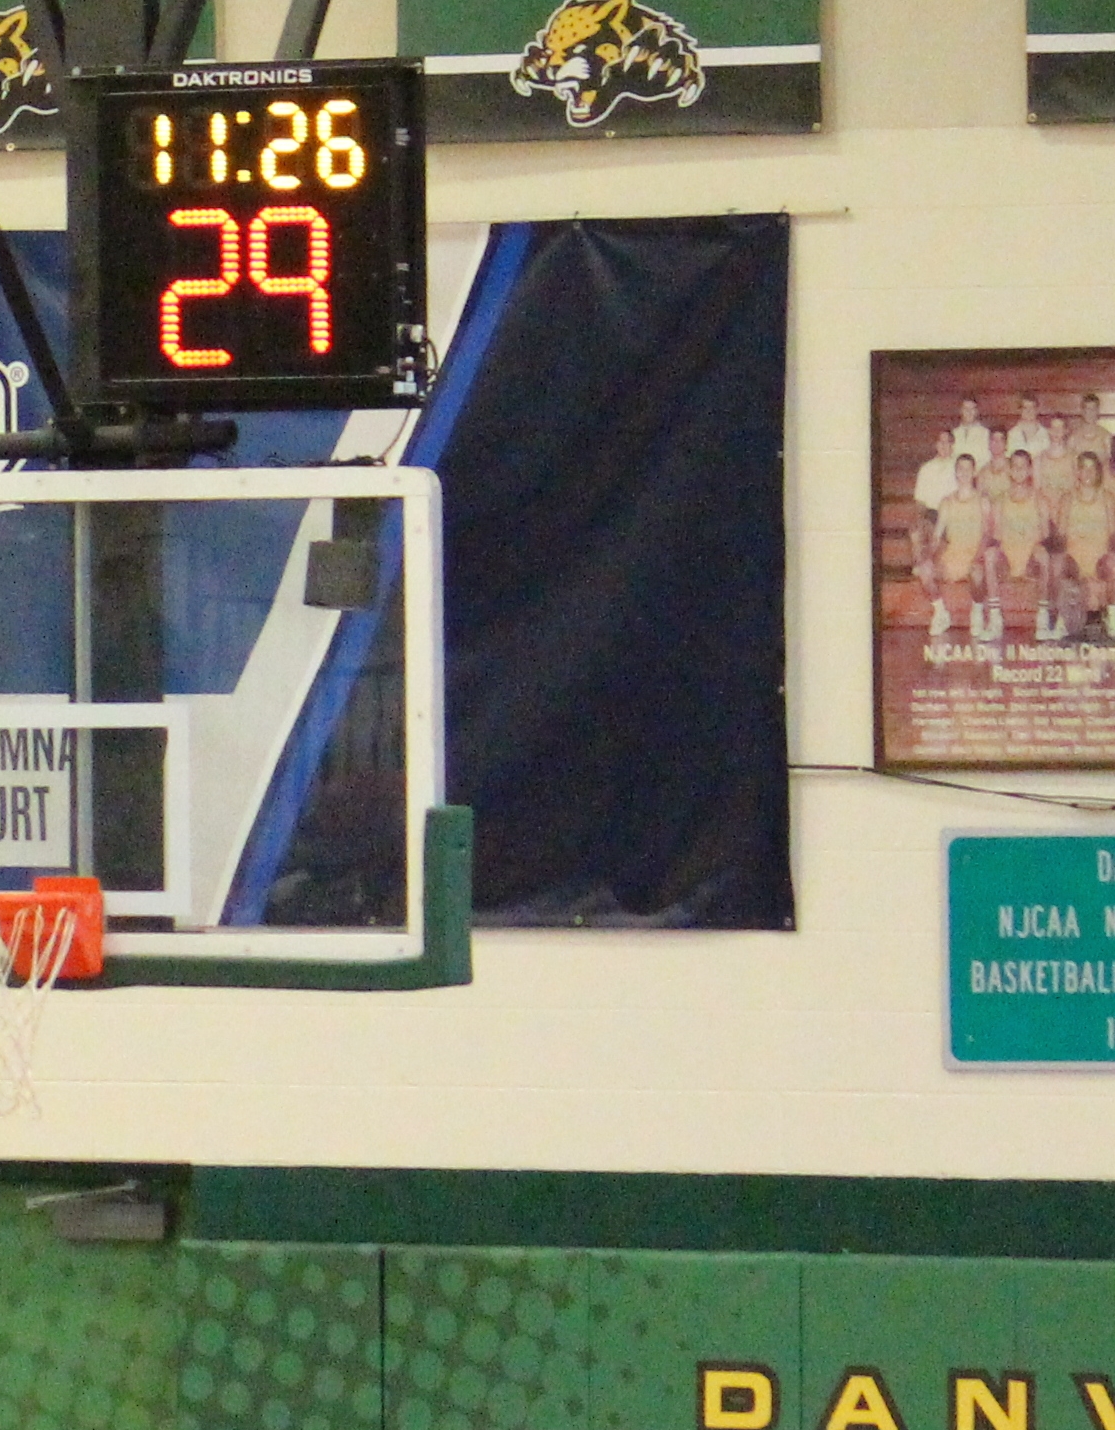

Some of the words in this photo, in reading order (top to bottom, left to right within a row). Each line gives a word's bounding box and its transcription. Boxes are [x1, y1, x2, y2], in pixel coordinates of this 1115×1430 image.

[173, 68, 313, 88] DAKTRONICS
[154, 99, 366, 190] 11:26
[159, 205, 332, 368] 29
[998, 905, 1081, 938] NJCAA
[970, 960, 1115, 993] BASKETBAL
